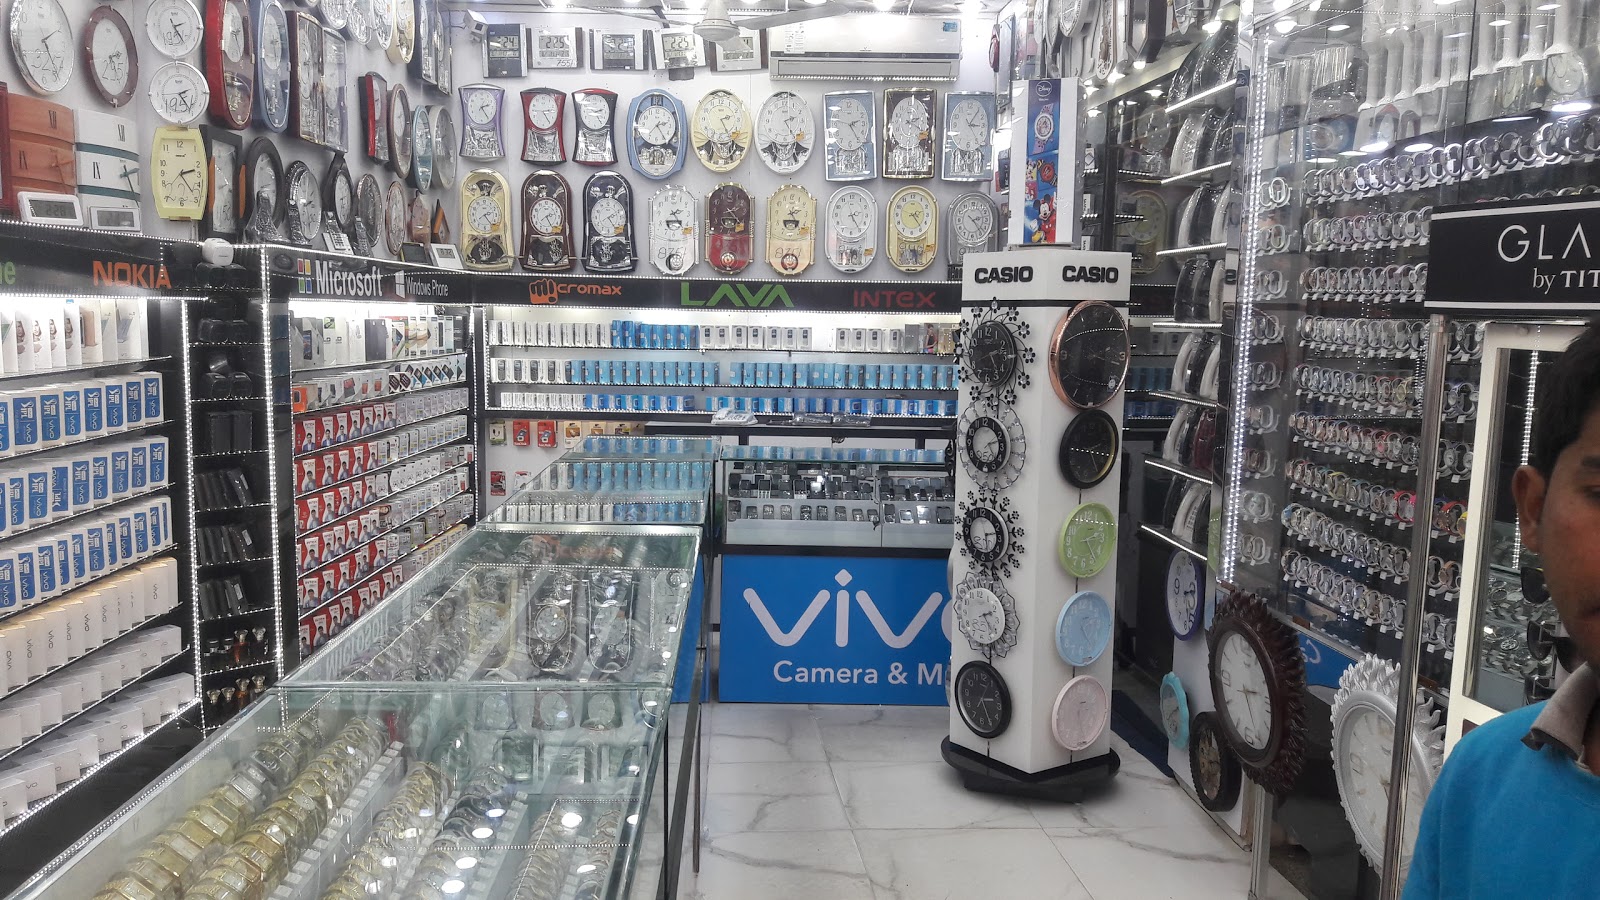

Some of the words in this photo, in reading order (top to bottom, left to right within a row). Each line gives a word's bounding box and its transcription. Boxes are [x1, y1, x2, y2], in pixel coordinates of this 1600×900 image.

[0, 259, 17, 286] e
[93, 260, 172, 289] NOKIA
[315, 259, 383, 297] Microsoft
[974, 266, 1034, 284] CASIO
[1062, 265, 1119, 284] CASIO
[1532, 267, 1556, 295] by
[406, 276, 431, 296] Windows
[432, 280, 449, 297] Phone
[680, 282, 795, 308] LAVA
[743, 568, 951, 649] viv
[773, 660, 878, 684] Camera
[888, 662, 908, 686] &
